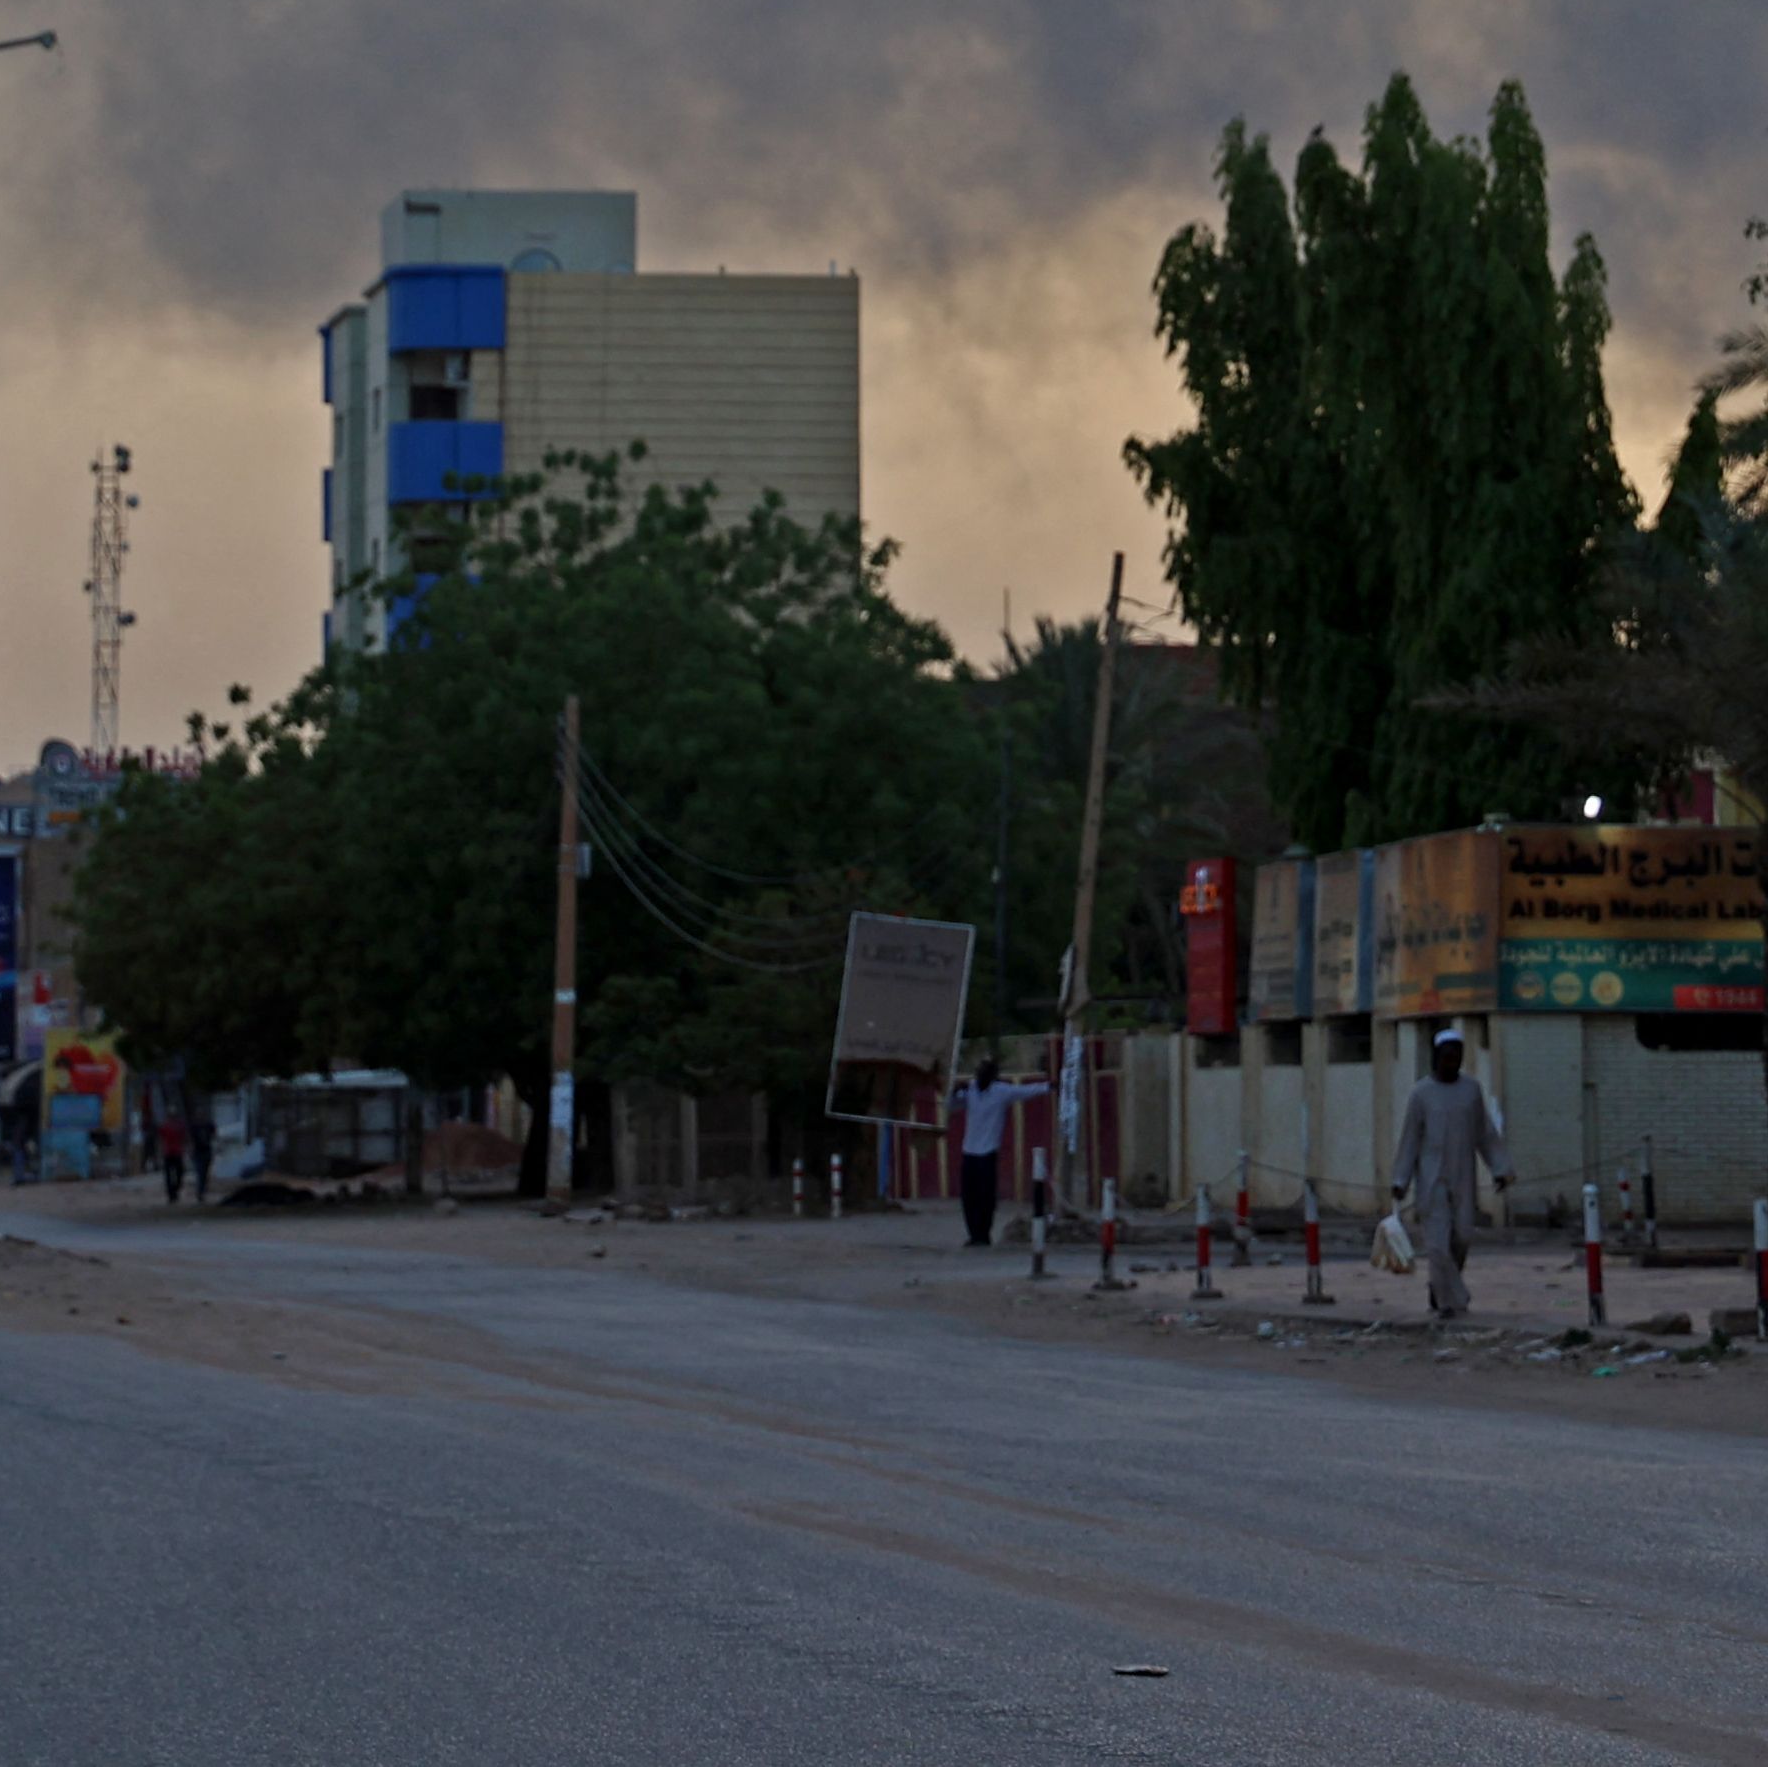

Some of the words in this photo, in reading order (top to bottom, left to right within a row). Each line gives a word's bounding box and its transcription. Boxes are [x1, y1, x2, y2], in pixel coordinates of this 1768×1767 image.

[1507, 837, 1620, 887] الطبية
[1628, 840, 1722, 887] البرج
[1510, 900, 1535, 918] Al
[1543, 899, 1601, 922] Borg
[1610, 899, 1709, 918] Medical
